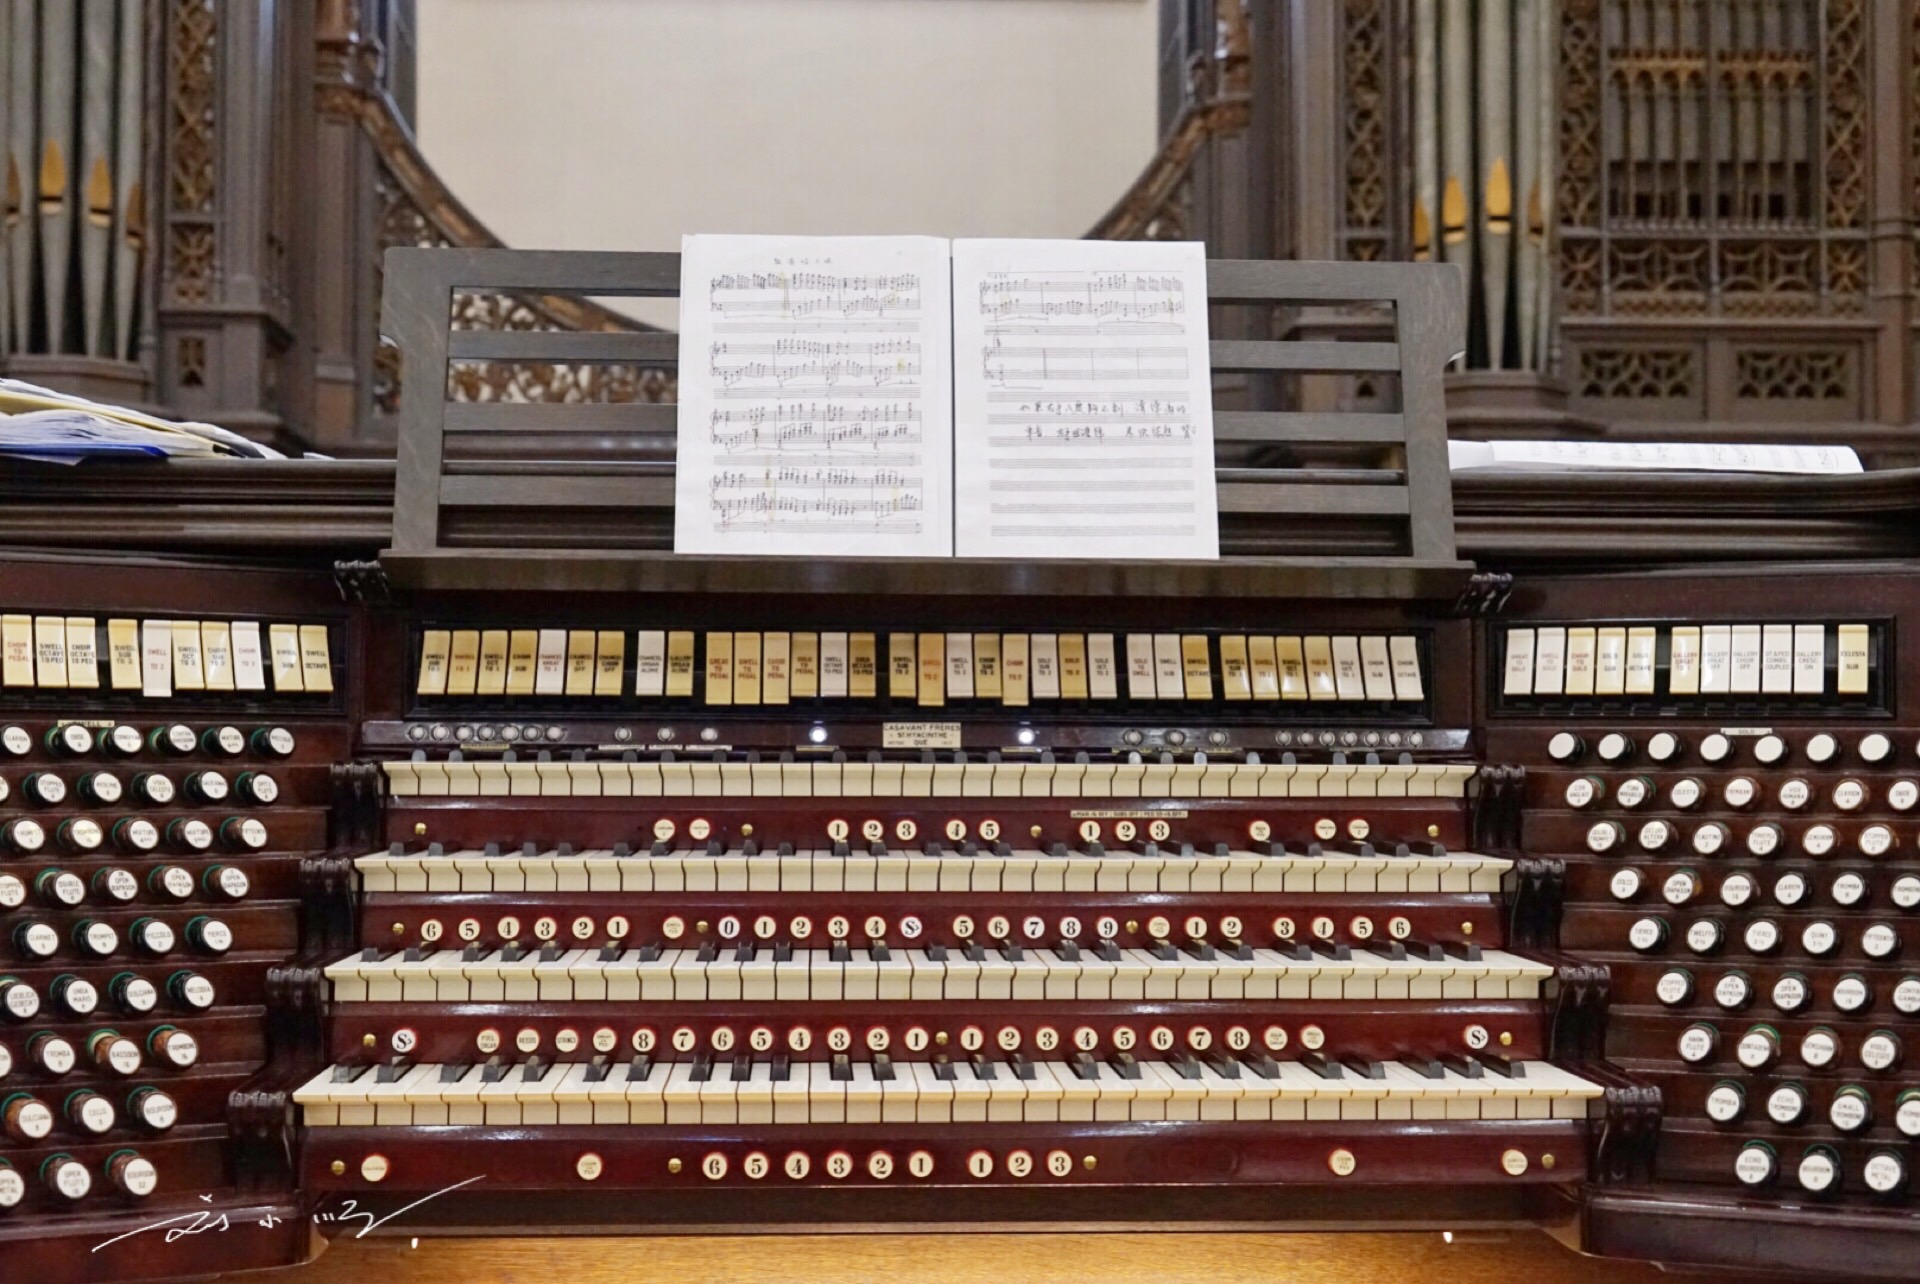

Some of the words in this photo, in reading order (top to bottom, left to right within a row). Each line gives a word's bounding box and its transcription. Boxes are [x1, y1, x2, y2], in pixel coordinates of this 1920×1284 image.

[869, 824, 878, 837] 2
[902, 824, 911, 836] 3
[950, 823, 960, 837] 4
[986, 823, 994, 836] 5
[1122, 825, 1131, 838] 2
[1156, 824, 1165, 837] 3
[426, 924, 436, 937] 6
[465, 923, 474, 936] 5
[502, 921, 511, 936] 4
[541, 922, 550, 936] 3
[579, 921, 588, 936] 2
[724, 921, 734, 935] 0
[796, 921, 805, 935] 2
[834, 920, 843, 934] 3
[870, 920, 879, 935] 4
[959, 920, 969, 934] 5
[994, 922, 1003, 933] 6
[1030, 921, 1039, 936] 7
[1066, 921, 1076, 935] 8
[1104, 922, 1113, 935] 9
[1227, 921, 1236, 935] 2
[1280, 921, 1290, 935] 3
[1317, 922, 1326, 935] 4
[1359, 921, 1367, 934] 5
[1396, 921, 1405, 934] 6
[638, 1033, 649, 1048] 8
[679, 1032, 689, 1048] 7
[718, 1033, 727, 1047] 6
[756, 1032, 766, 1046] 5
[794, 1032, 804, 1047] 4
[834, 1033, 845, 1047] 3
[873, 1033, 884, 1047] 2
[1005, 1032, 1015, 1047] 2
[1043, 1032, 1053, 1047] 3
[1081, 1032, 1090, 1047] 4
[1120, 1031, 1130, 1046] 5
[1157, 1032, 1167, 1046] 6
[1195, 1031, 1206, 1047] 7
[1234, 1031, 1244, 1046] 8
[709, 1159, 720, 1175] 6
[751, 1158, 762, 1174] 5
[791, 1158, 802, 1175] 4
[833, 1158, 844, 1174] 3
[876, 1159, 886, 1175] 2
[1015, 1157, 1025, 1173] 2
[1055, 1157, 1065, 1172] 3
